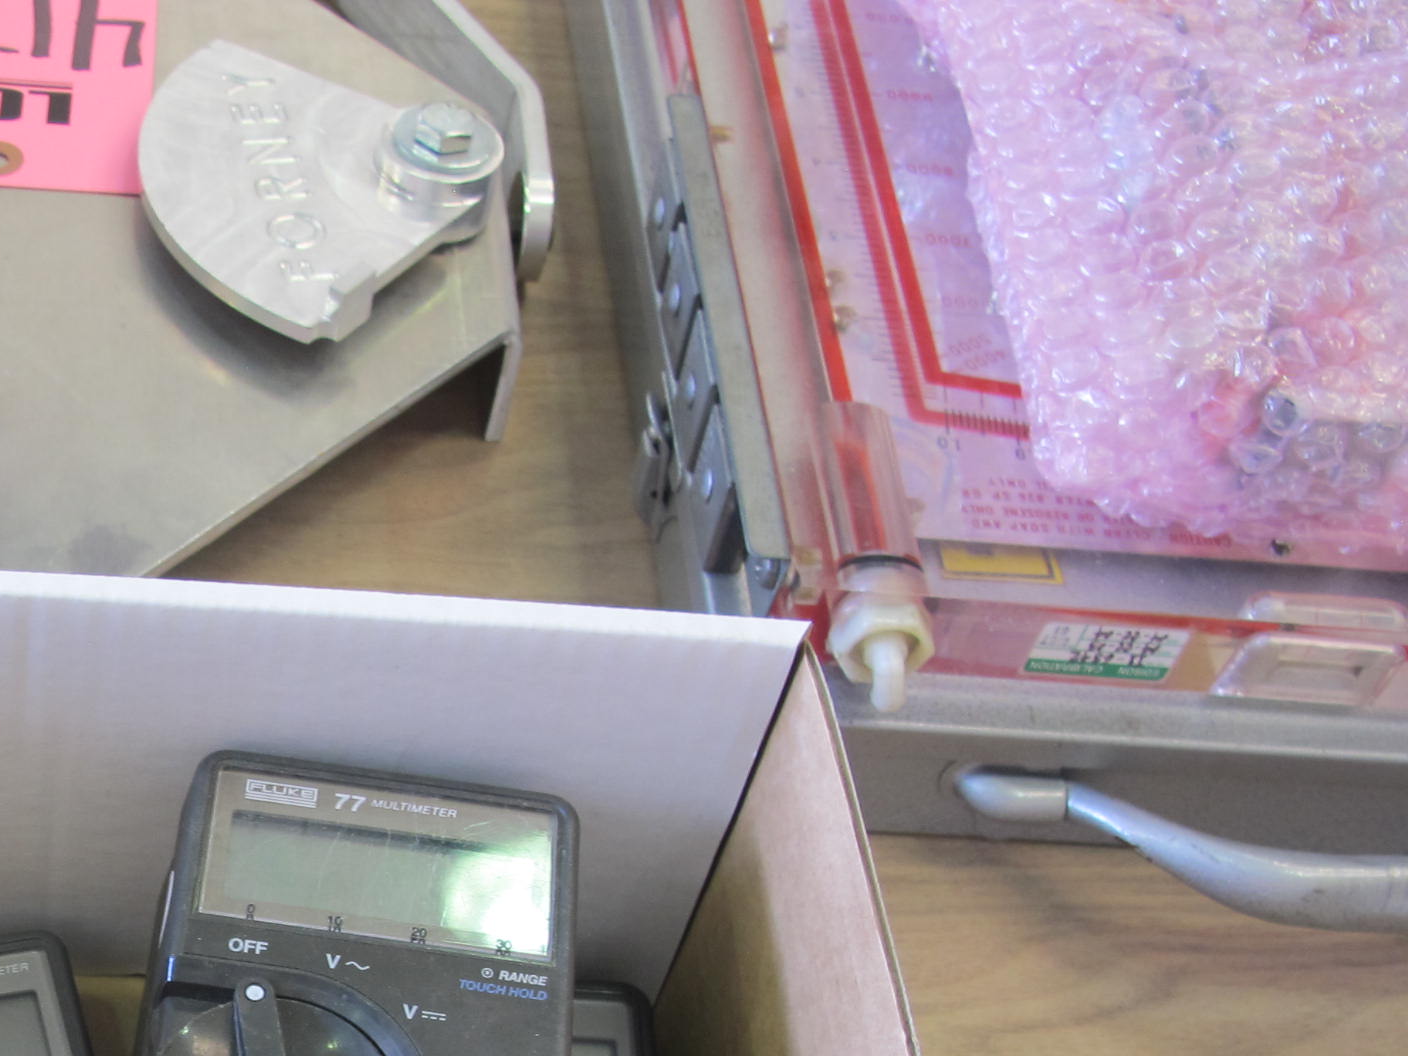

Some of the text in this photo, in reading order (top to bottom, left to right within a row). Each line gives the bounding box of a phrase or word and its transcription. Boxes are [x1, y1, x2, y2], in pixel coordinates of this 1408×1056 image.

[222, 72, 341, 284] FORNEY
[248, 781, 457, 819] FLUKE 77 MULTIMETER
[228, 937, 268, 957] OFF
[499, 968, 548, 986] RANGE
[458, 978, 548, 1001] TOUCH HOLD
